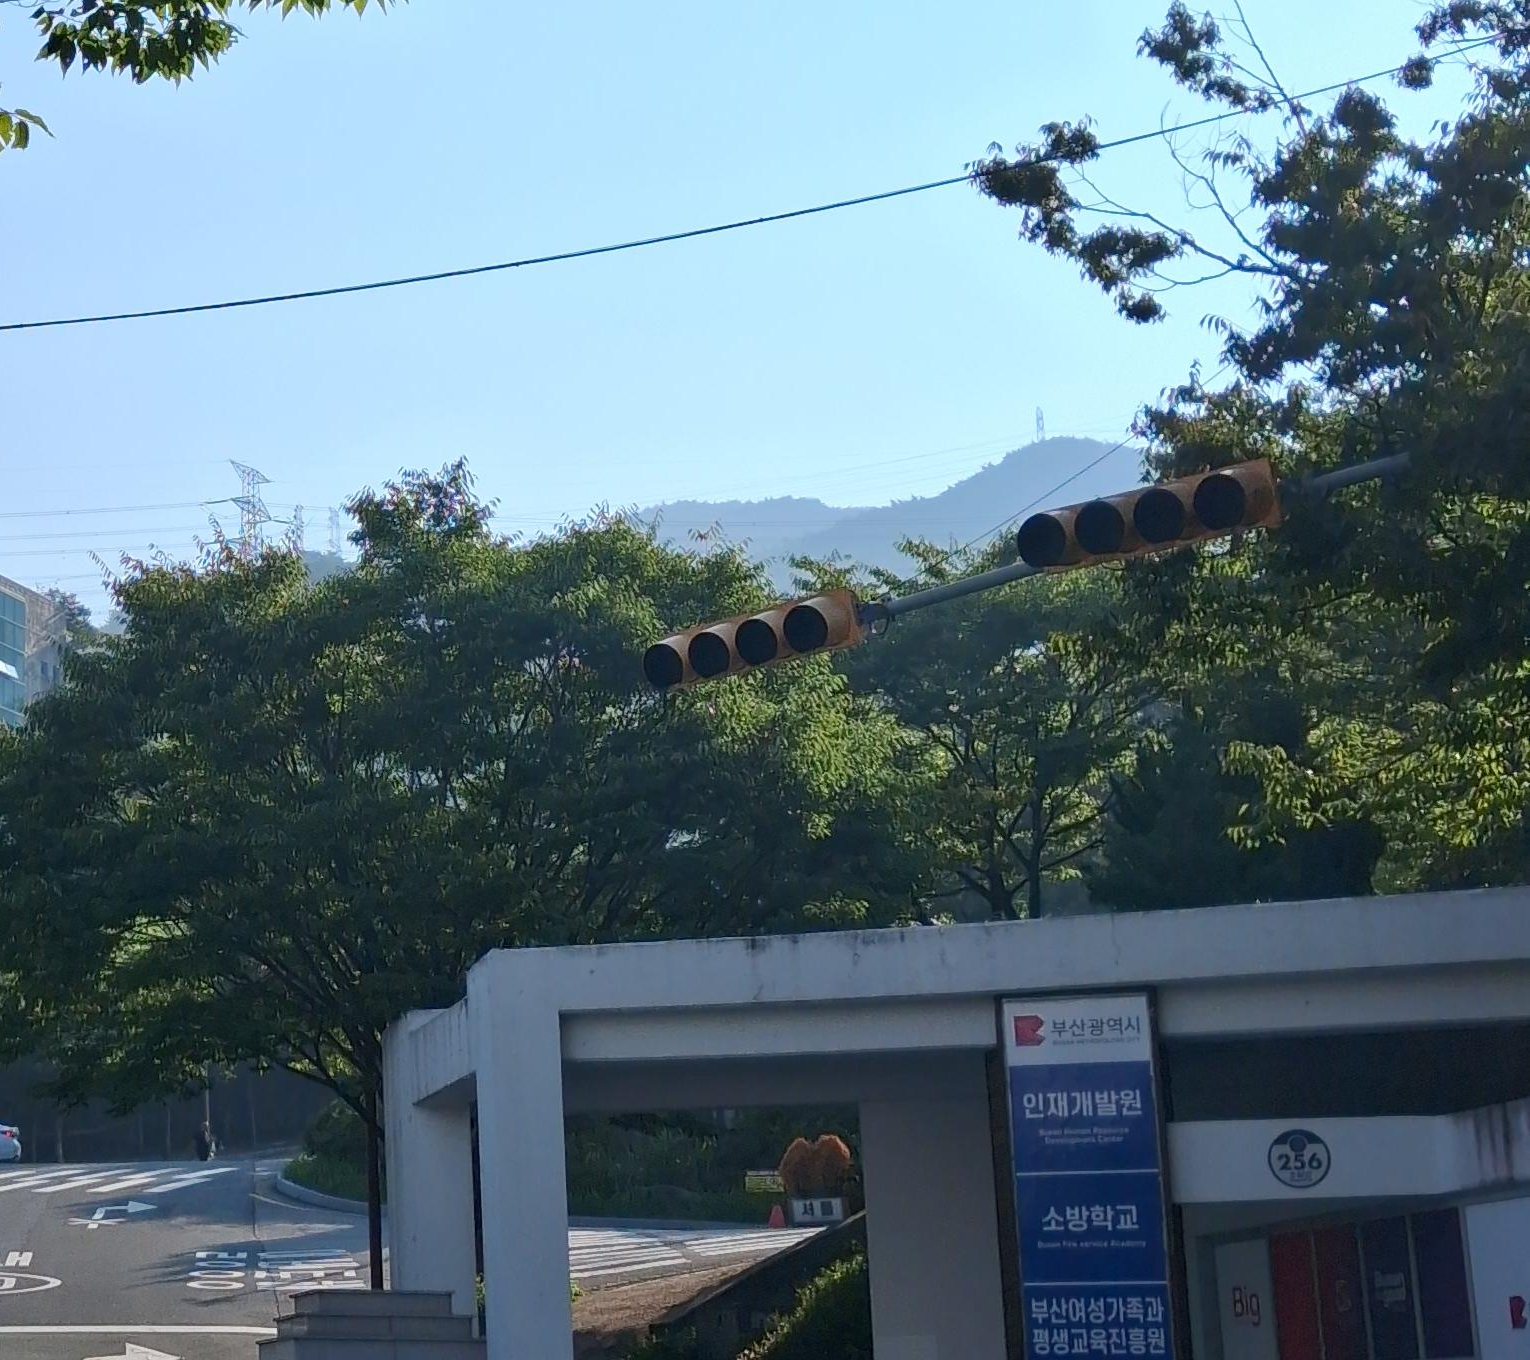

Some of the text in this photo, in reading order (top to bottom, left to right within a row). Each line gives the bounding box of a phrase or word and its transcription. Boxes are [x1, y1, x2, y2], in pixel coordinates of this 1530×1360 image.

[1051, 1015, 1141, 1038] 부산광역시
[1022, 1089, 1143, 1119] 인재개발원
[1277, 1152, 1323, 1171] 256
[1041, 1204, 1139, 1232] 소방학교
[1031, 1296, 1164, 1324] 부산여성가족과
[1232, 1285, 1261, 1327] Big
[1033, 1328, 1166, 1354] 평생교육진흥원
